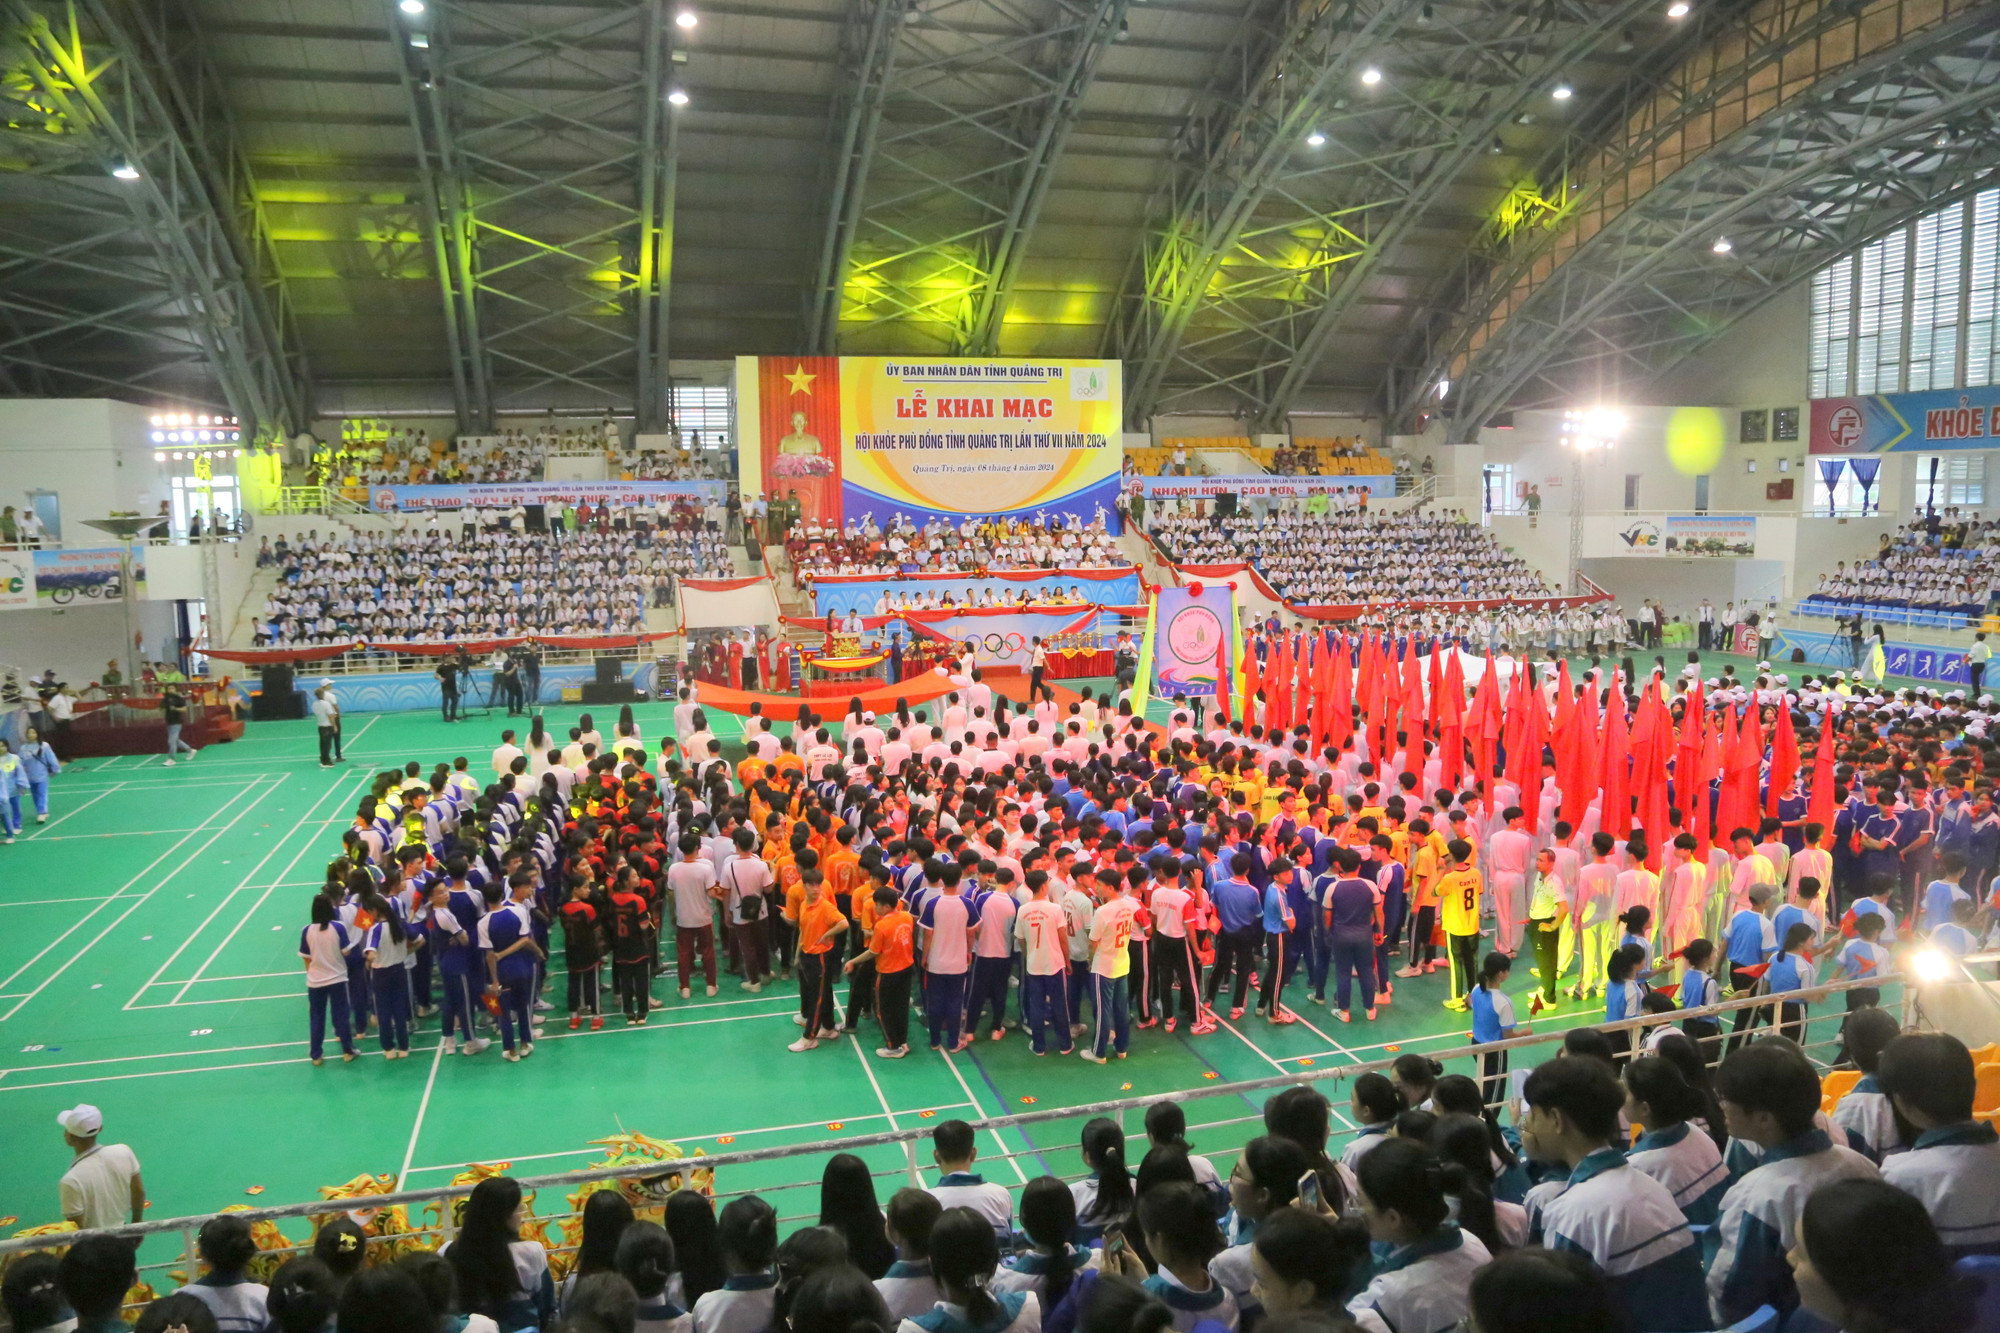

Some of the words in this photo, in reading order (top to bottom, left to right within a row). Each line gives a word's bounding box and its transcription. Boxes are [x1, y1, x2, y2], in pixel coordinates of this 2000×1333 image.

[886, 362, 900, 376] ỦY
[903, 366, 925, 376] BAN
[928, 365, 957, 376] NHÂN
[960, 365, 981, 376] DÂN
[984, 363, 1007, 377] TỈNH
[1010, 363, 1044, 377] QUẢNG
[1048, 367, 1063, 379] TRỊ
[896, 389, 928, 418] LỄ
[937, 398, 994, 418] KHAI
[1003, 398, 1053, 423] MẠC
[1926, 395, 1984, 439] KHỎE
[855, 432, 871, 453] HỘI
[873, 430, 896, 449] KHỎE
[899, 432, 917, 449] PHÙ
[945, 430, 965, 449] TỈNH
[968, 430, 997, 449] QUẢNG
[1000, 434, 1013, 452] TRỊ
[1034, 431, 1050, 448] THỨ
[1052, 434, 1063, 448] VII
[1065, 431, 1084, 448] NĂM
[1086, 434, 1107, 448] 2024
[988, 464, 1011, 472] tháng
[1151, 487, 1197, 495] NHANH
[1201, 486, 1228, 495] HƠN
[1240, 486, 1265, 495] CAO
[431, 498, 461, 507] THAO
[1619, 528, 1658, 547] VHC
[1464, 887, 1475, 911] 8
[617, 913, 629, 937] 6
[1031, 922, 1042, 949] 7
